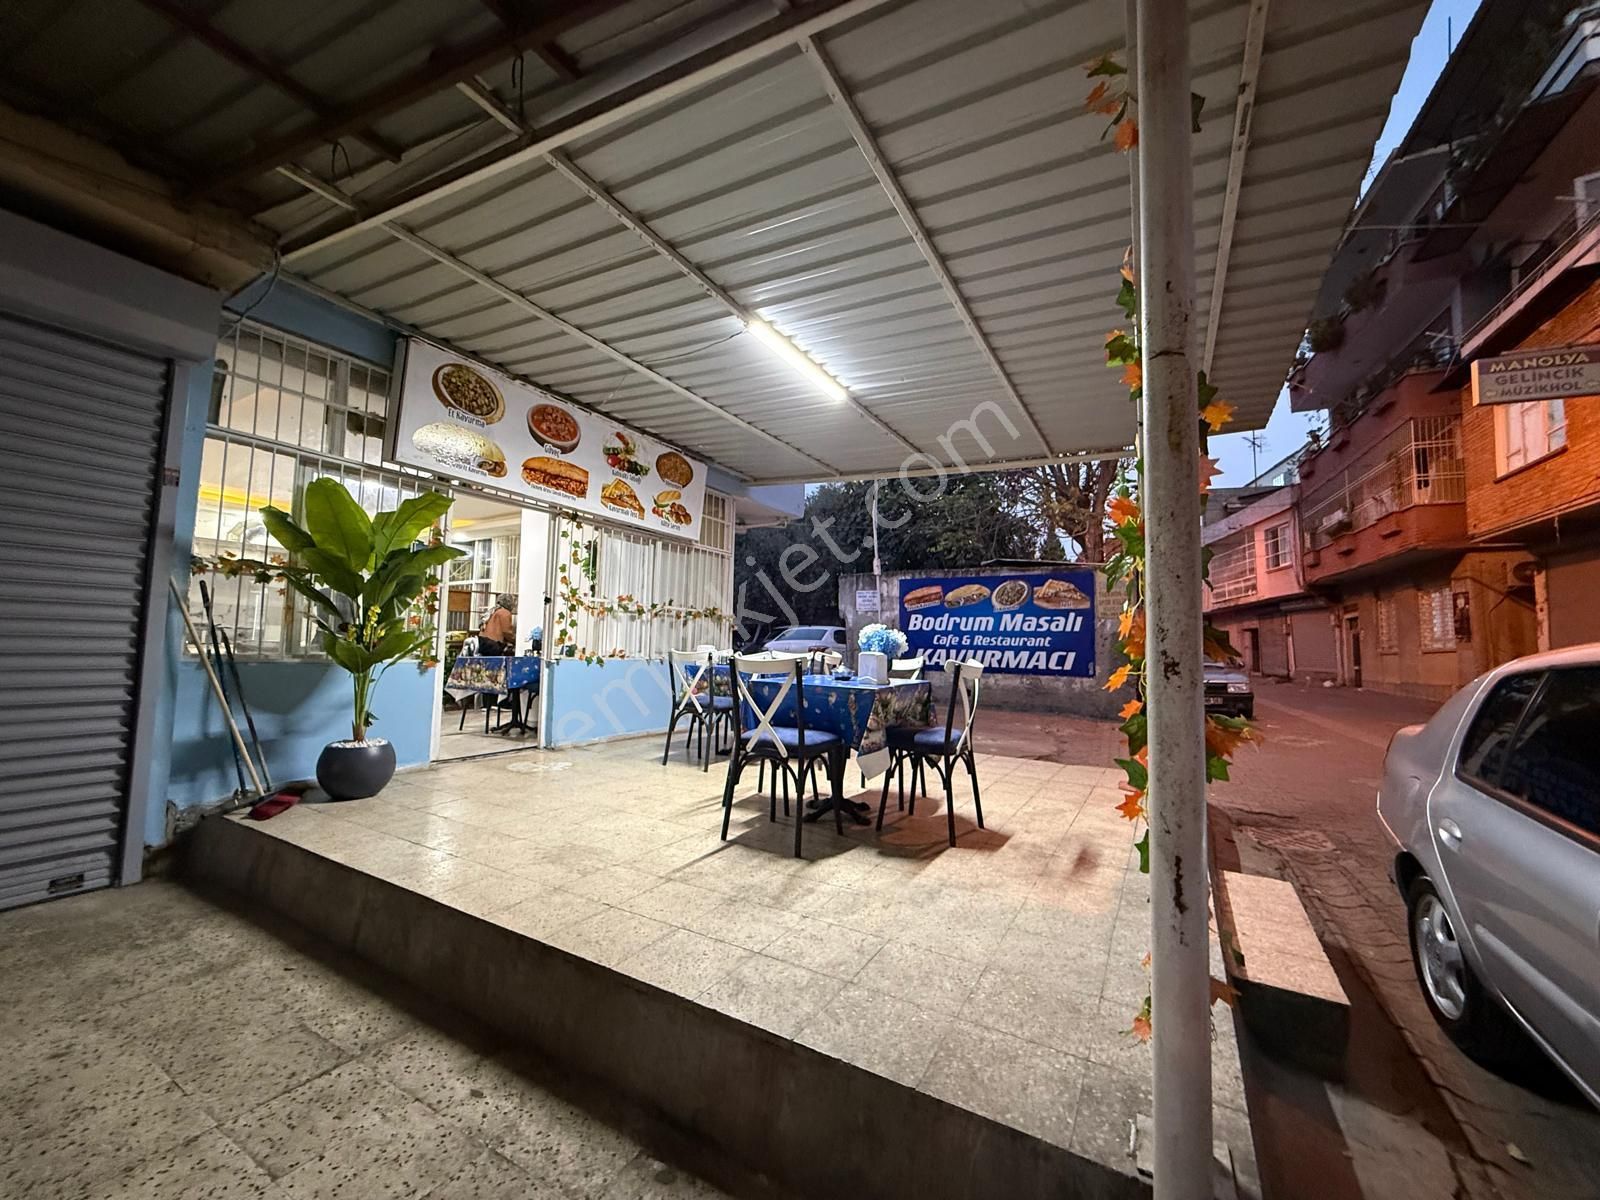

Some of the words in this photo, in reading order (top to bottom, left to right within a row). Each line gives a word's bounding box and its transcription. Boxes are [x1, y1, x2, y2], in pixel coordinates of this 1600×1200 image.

[1490, 353, 1590, 373] MANOLYA
[908, 613, 994, 631] Bodrum
[1000, 612, 1083, 632] Masalı
[933, 634, 958, 647] Cafe
[962, 635, 970, 645] &
[973, 635, 1052, 647] Restaurant
